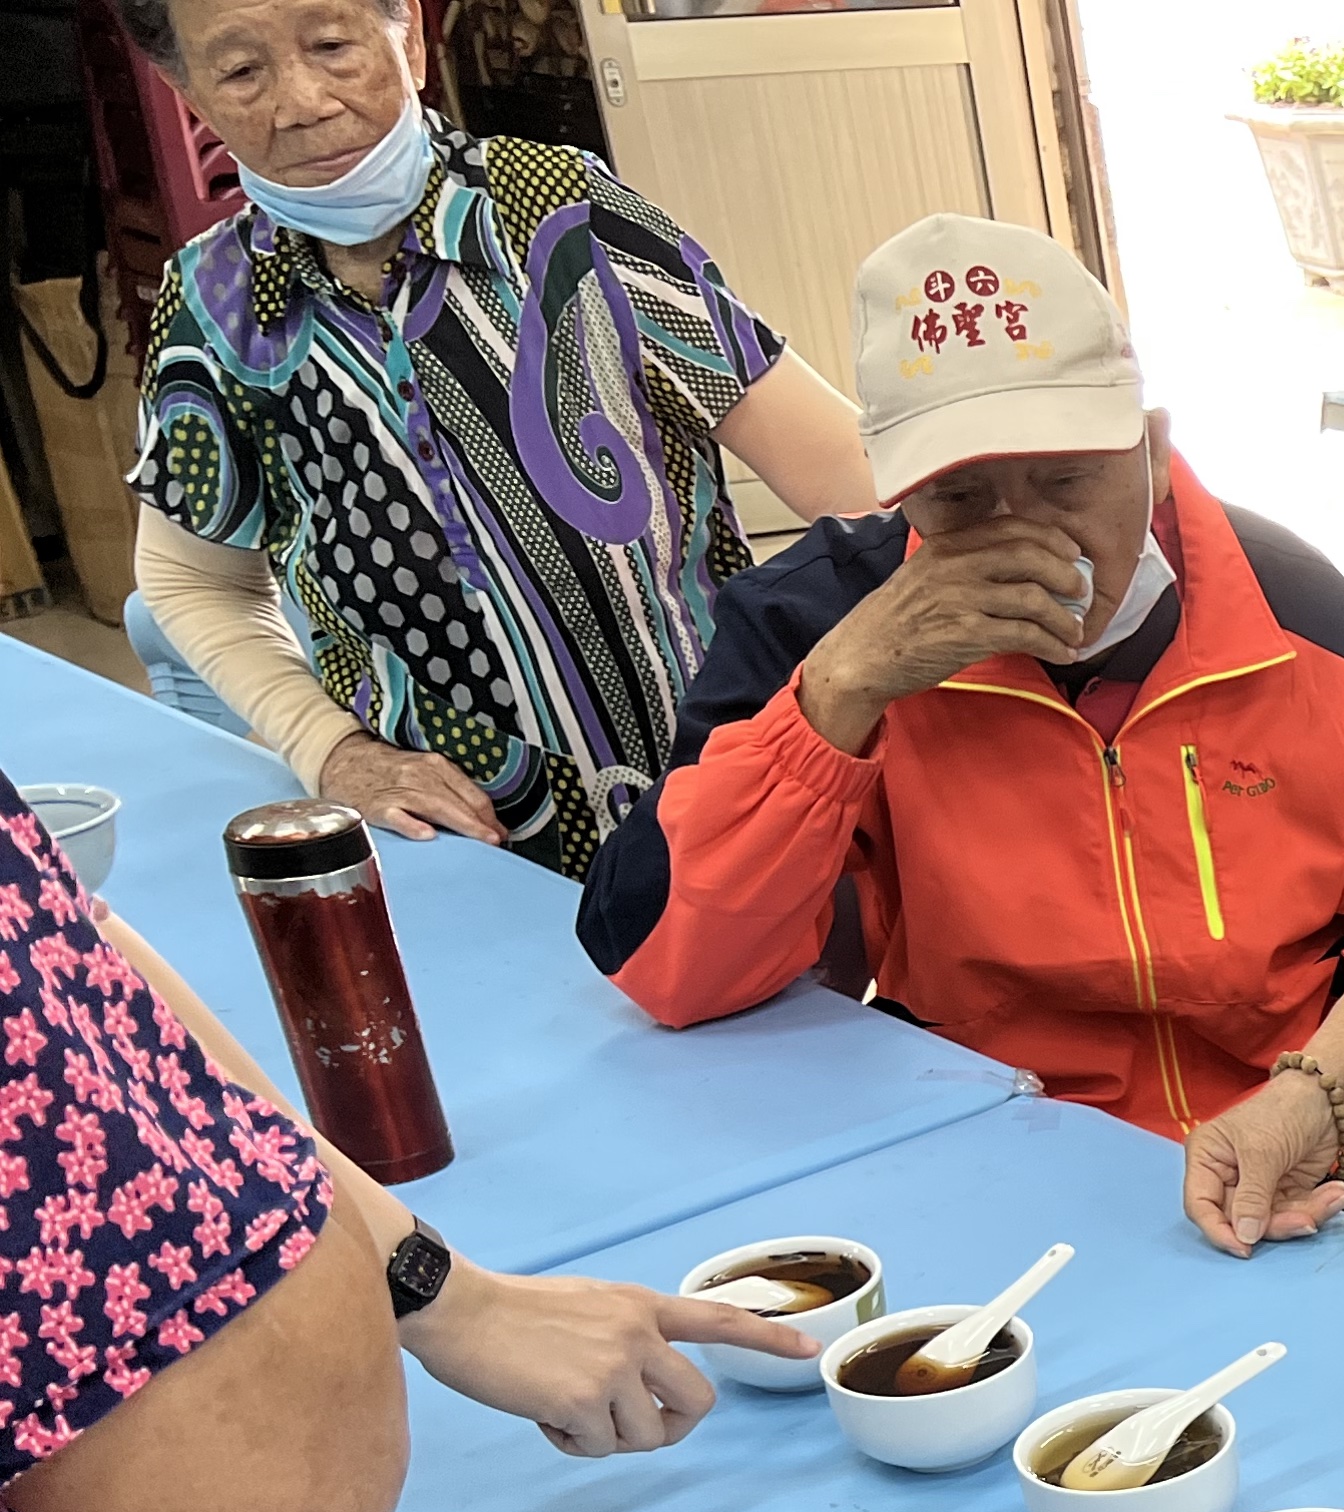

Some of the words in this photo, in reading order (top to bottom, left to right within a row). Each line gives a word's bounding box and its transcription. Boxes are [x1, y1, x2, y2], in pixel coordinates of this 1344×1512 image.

[925, 266, 999, 302] 斗六
[911, 300, 1028, 354] 佛聖宮
